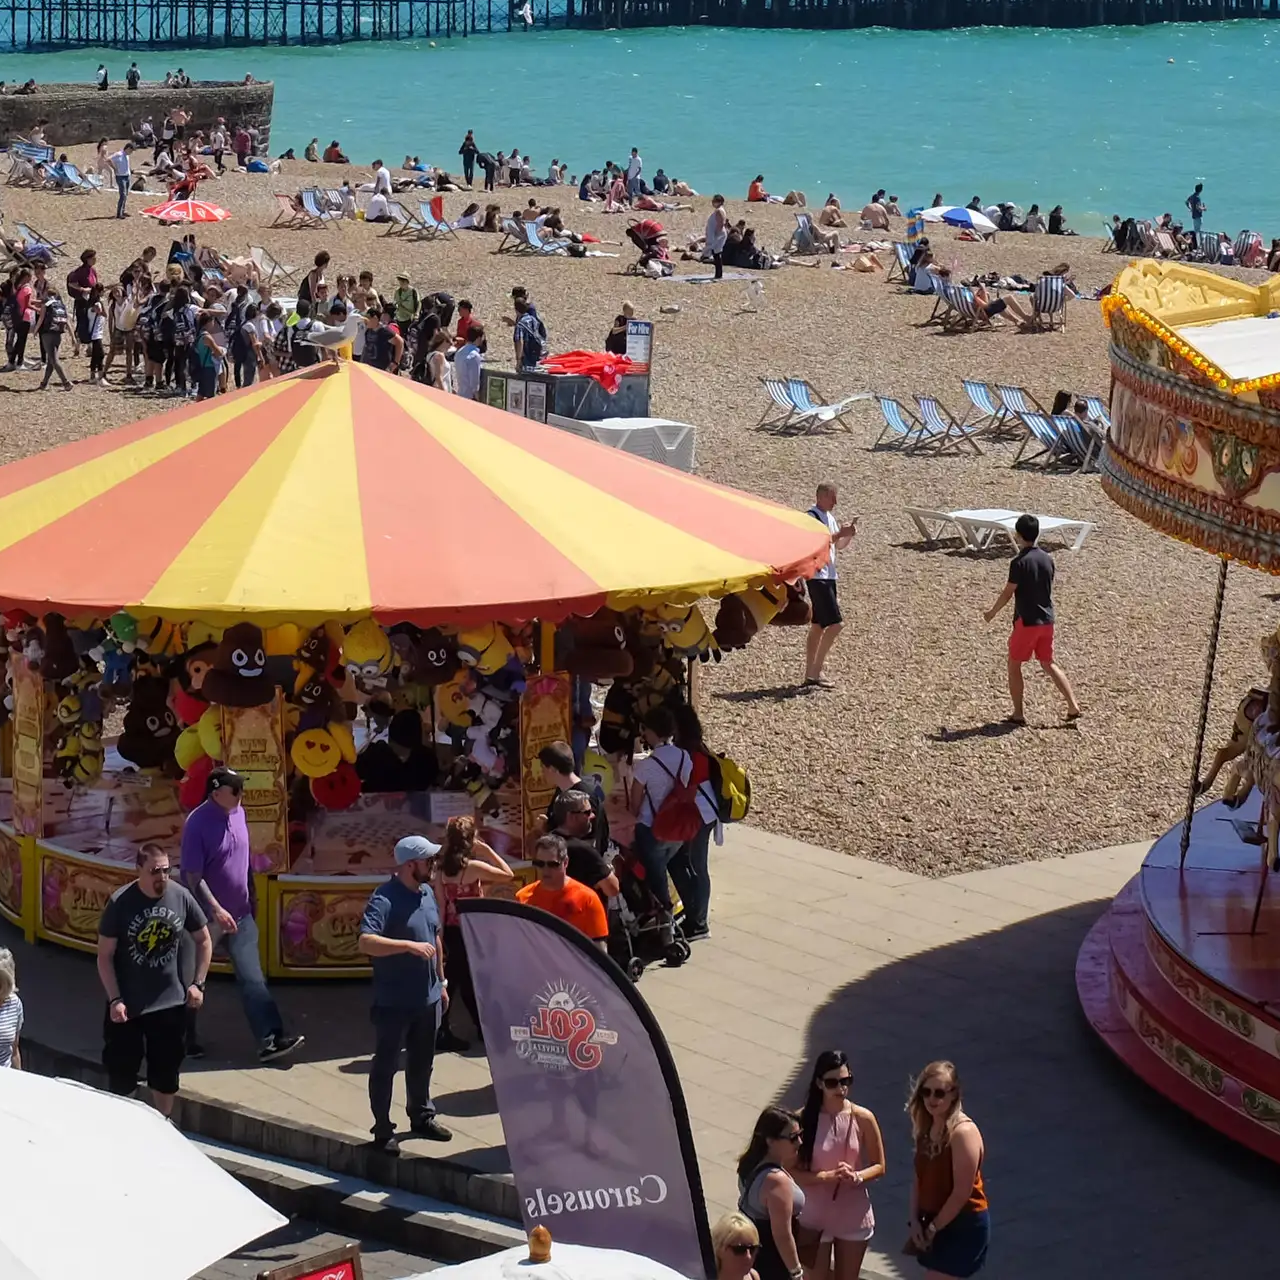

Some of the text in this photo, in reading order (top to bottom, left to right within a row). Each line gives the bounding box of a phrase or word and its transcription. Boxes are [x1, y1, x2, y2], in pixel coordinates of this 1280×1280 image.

[127, 906, 184, 937] THE BEST IN
[128, 943, 145, 966] THE
